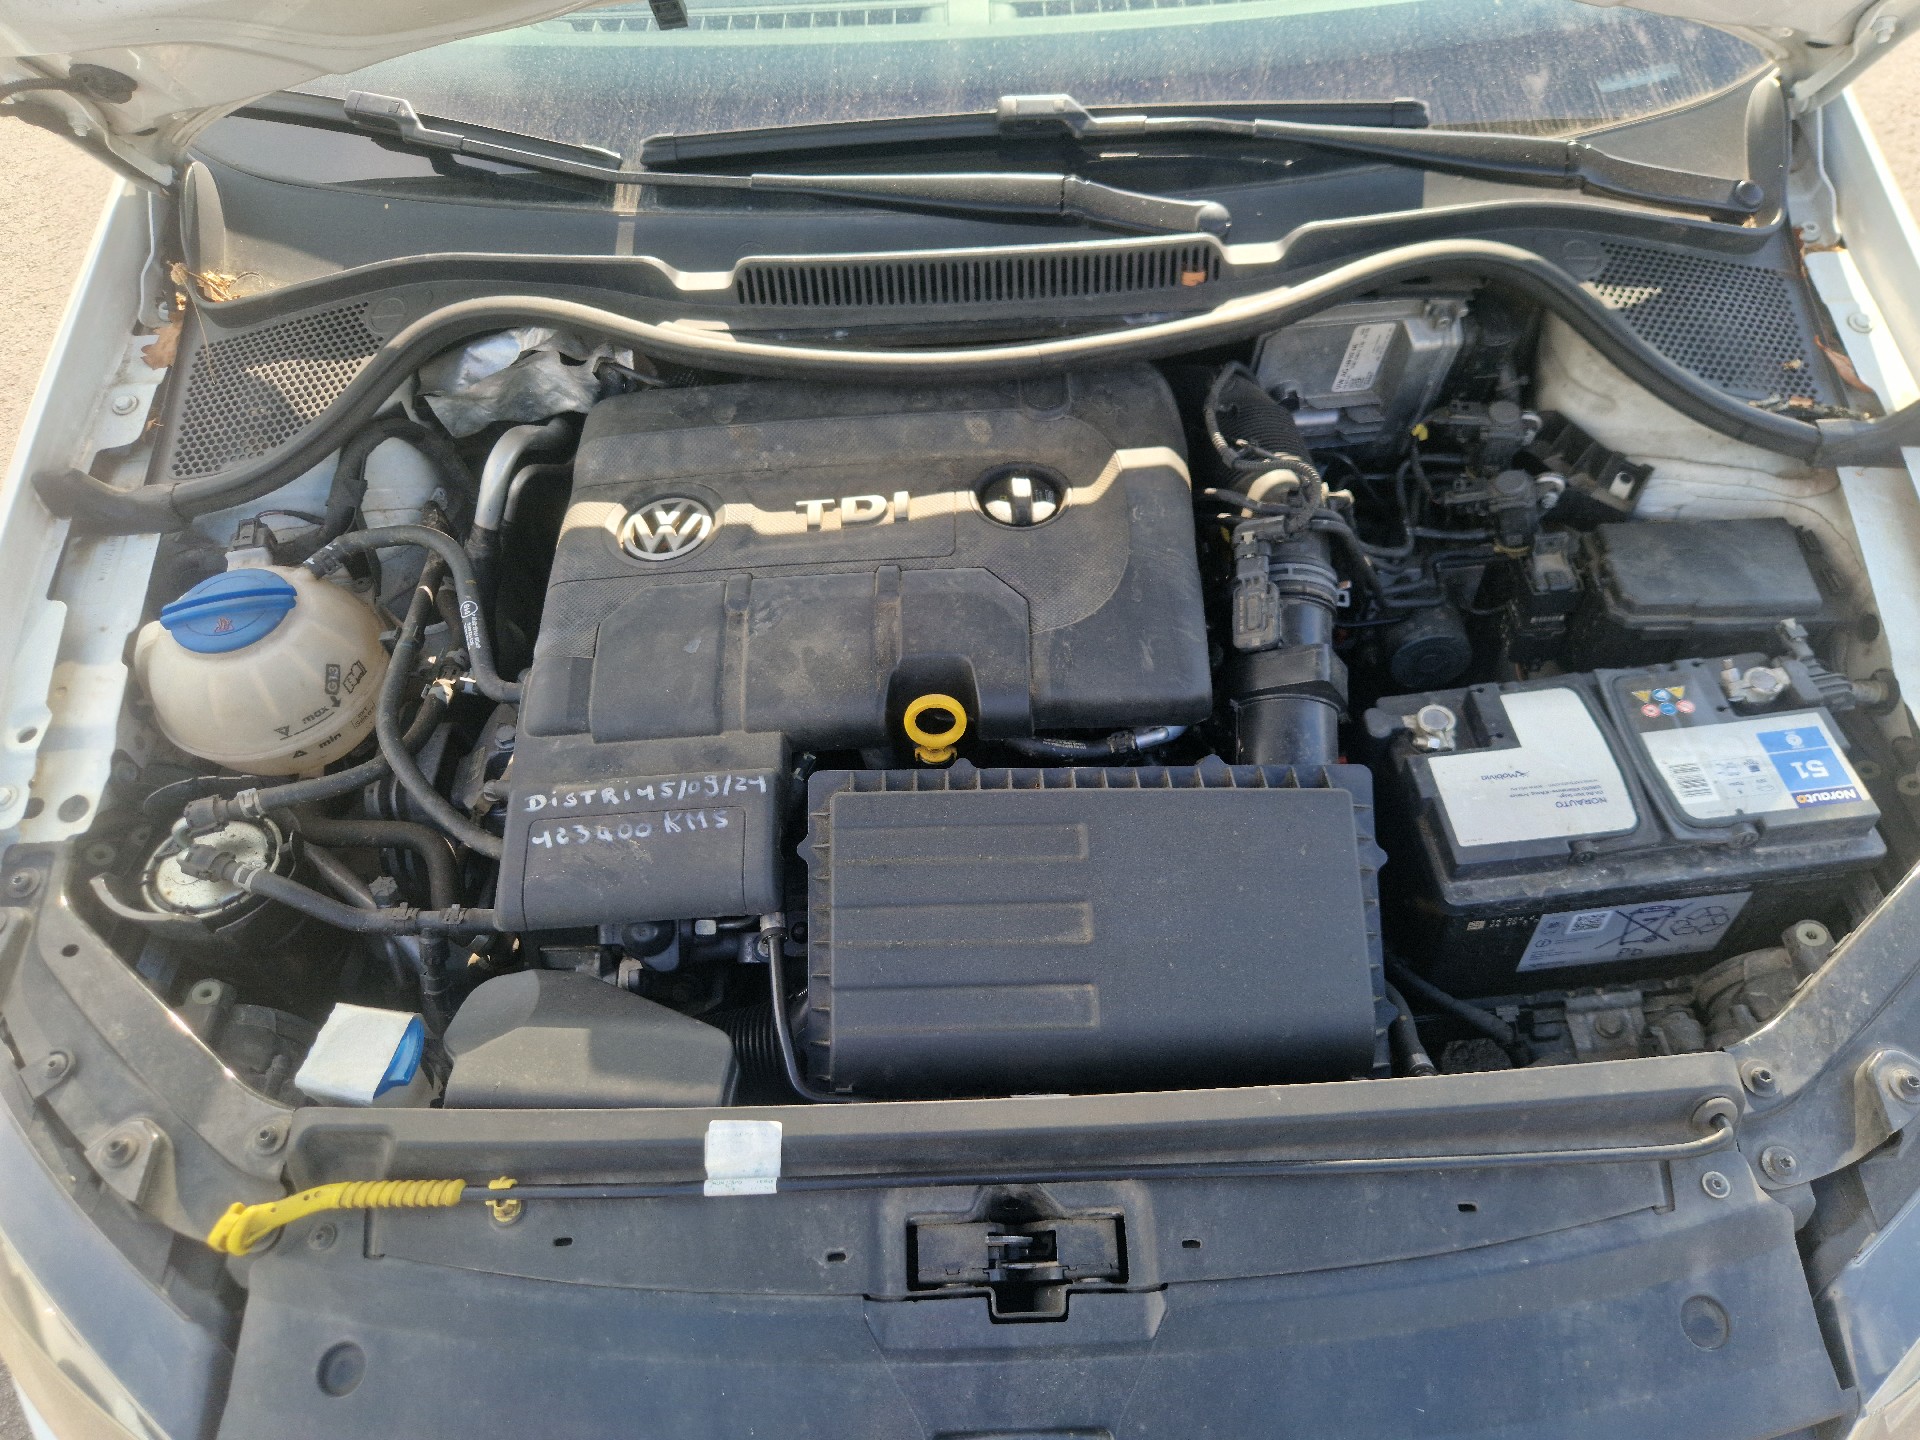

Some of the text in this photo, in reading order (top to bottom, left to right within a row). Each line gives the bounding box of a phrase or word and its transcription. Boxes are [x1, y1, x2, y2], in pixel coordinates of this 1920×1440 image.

[796, 490, 911, 531] TDI
[327, 666, 339, 692] G13
[302, 705, 330, 724] max
[318, 732, 342, 748] min
[1790, 759, 1830, 779] 51
[1555, 796, 1608, 809] NORAUTO
[1796, 788, 1857, 804] Norauto
[663, 810, 729, 834] KMS
